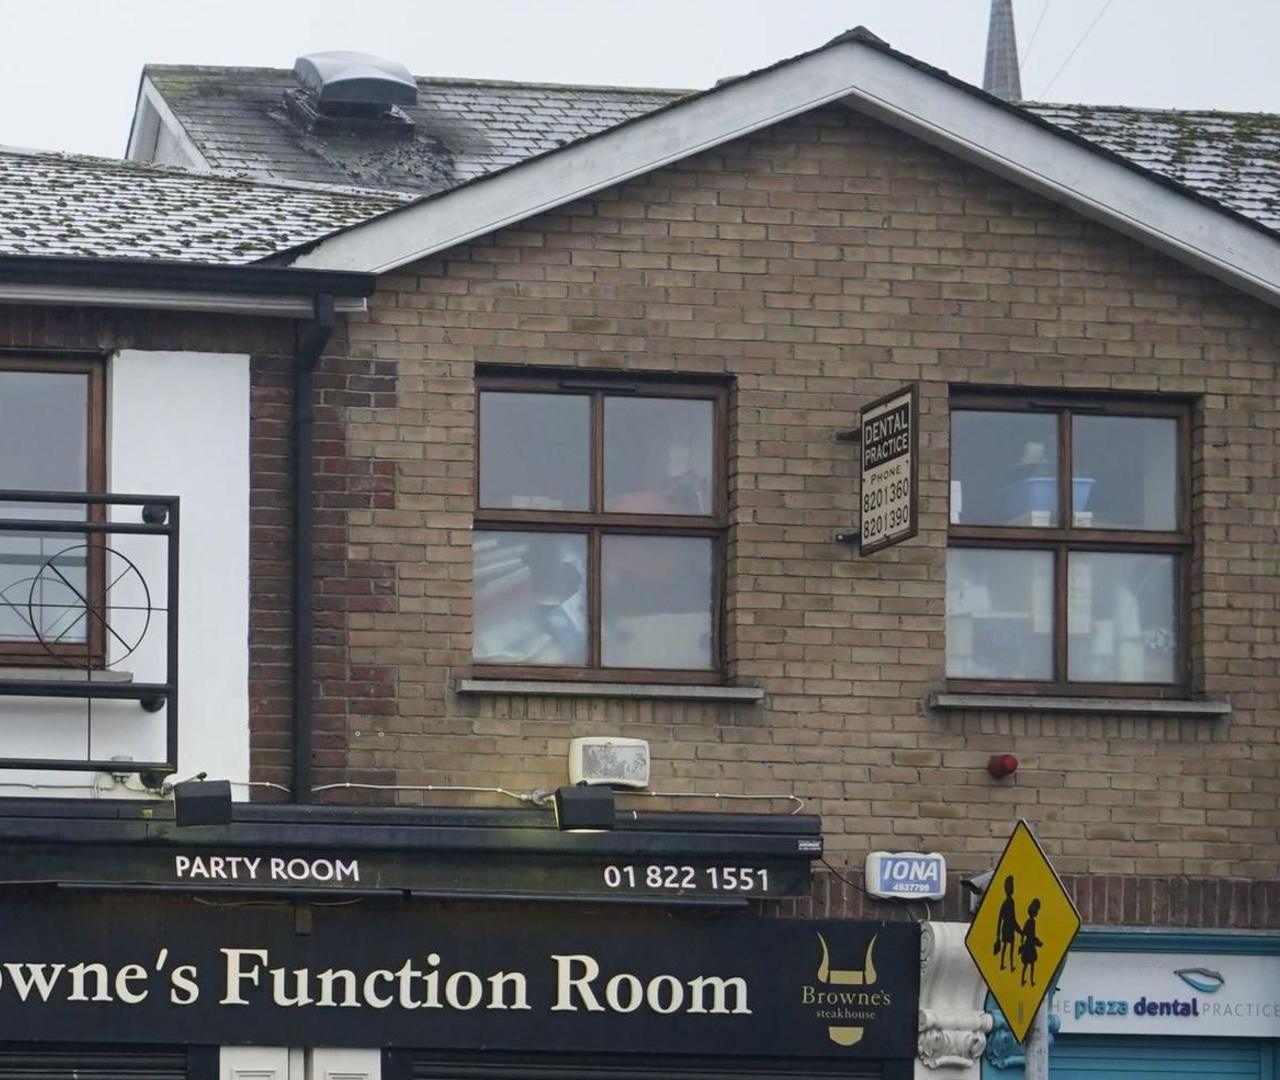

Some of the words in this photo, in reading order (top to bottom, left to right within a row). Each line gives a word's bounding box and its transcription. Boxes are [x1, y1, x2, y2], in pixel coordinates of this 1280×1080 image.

[865, 409, 908, 445] DENTAL
[864, 432, 908, 466] PRACTICE
[870, 464, 901, 486] PHONE
[863, 477, 909, 513] 8201360
[863, 505, 909, 539] 8201390
[175, 855, 261, 880] PARTY
[270, 858, 360, 882] ROOM
[604, 865, 636, 888] 01
[646, 865, 697, 889] 822
[706, 867, 768, 891] 1551
[884, 860, 938, 881] IONA
[218, 947, 532, 1011] Function
[550, 954, 753, 1015] Room
[801, 985, 890, 1006] Browne's
[1074, 995, 1129, 1020] plaza
[1133, 996, 1200, 1018] dental
[1202, 1002, 1280, 1018] PRACTICE
[816, 1009, 875, 1020] steakhouse
